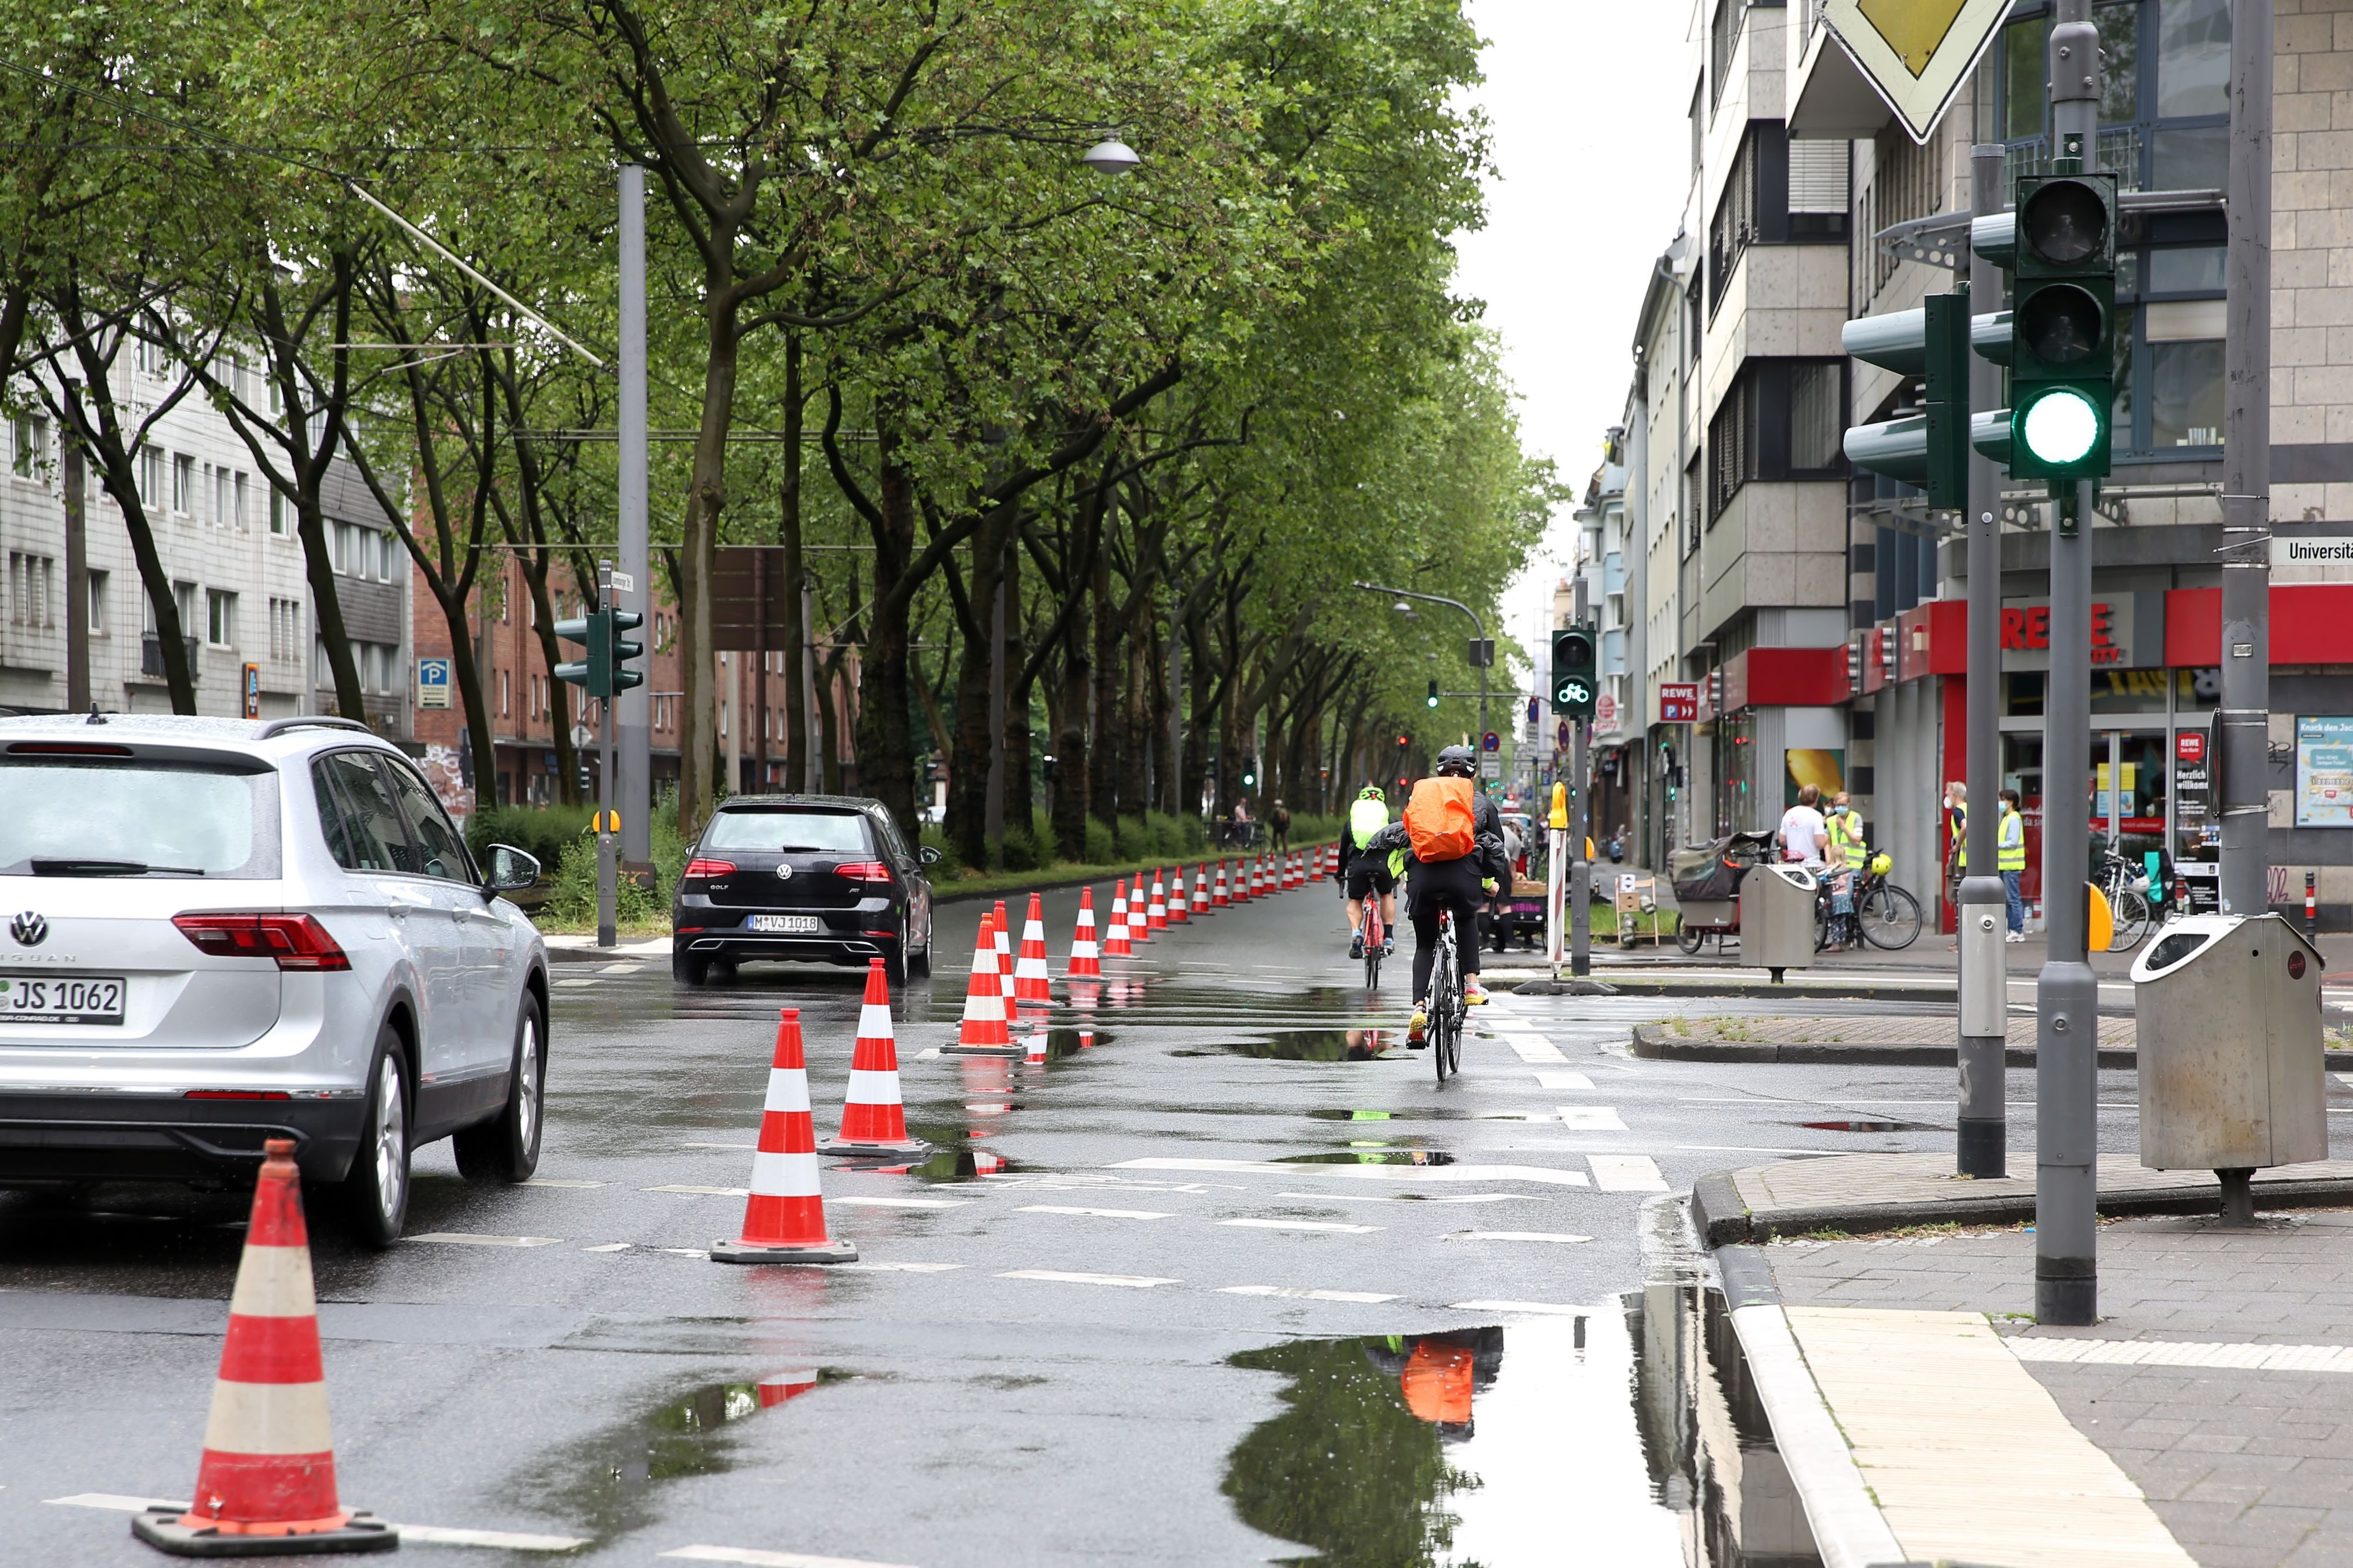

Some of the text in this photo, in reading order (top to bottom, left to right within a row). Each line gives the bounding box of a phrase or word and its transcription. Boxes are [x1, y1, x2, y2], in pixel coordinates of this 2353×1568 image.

[2001, 603, 2108, 649] REE
[1661, 688, 1694, 698] REWE
[2180, 739, 2199, 747] REWE
[2177, 769, 2206, 779] Herzlich
[755, 916, 762, 928] M
[788, 918, 816, 929] 1018
[0, 953, 76, 962] IGUAN
[14, 982, 118, 1011] JS 1062
